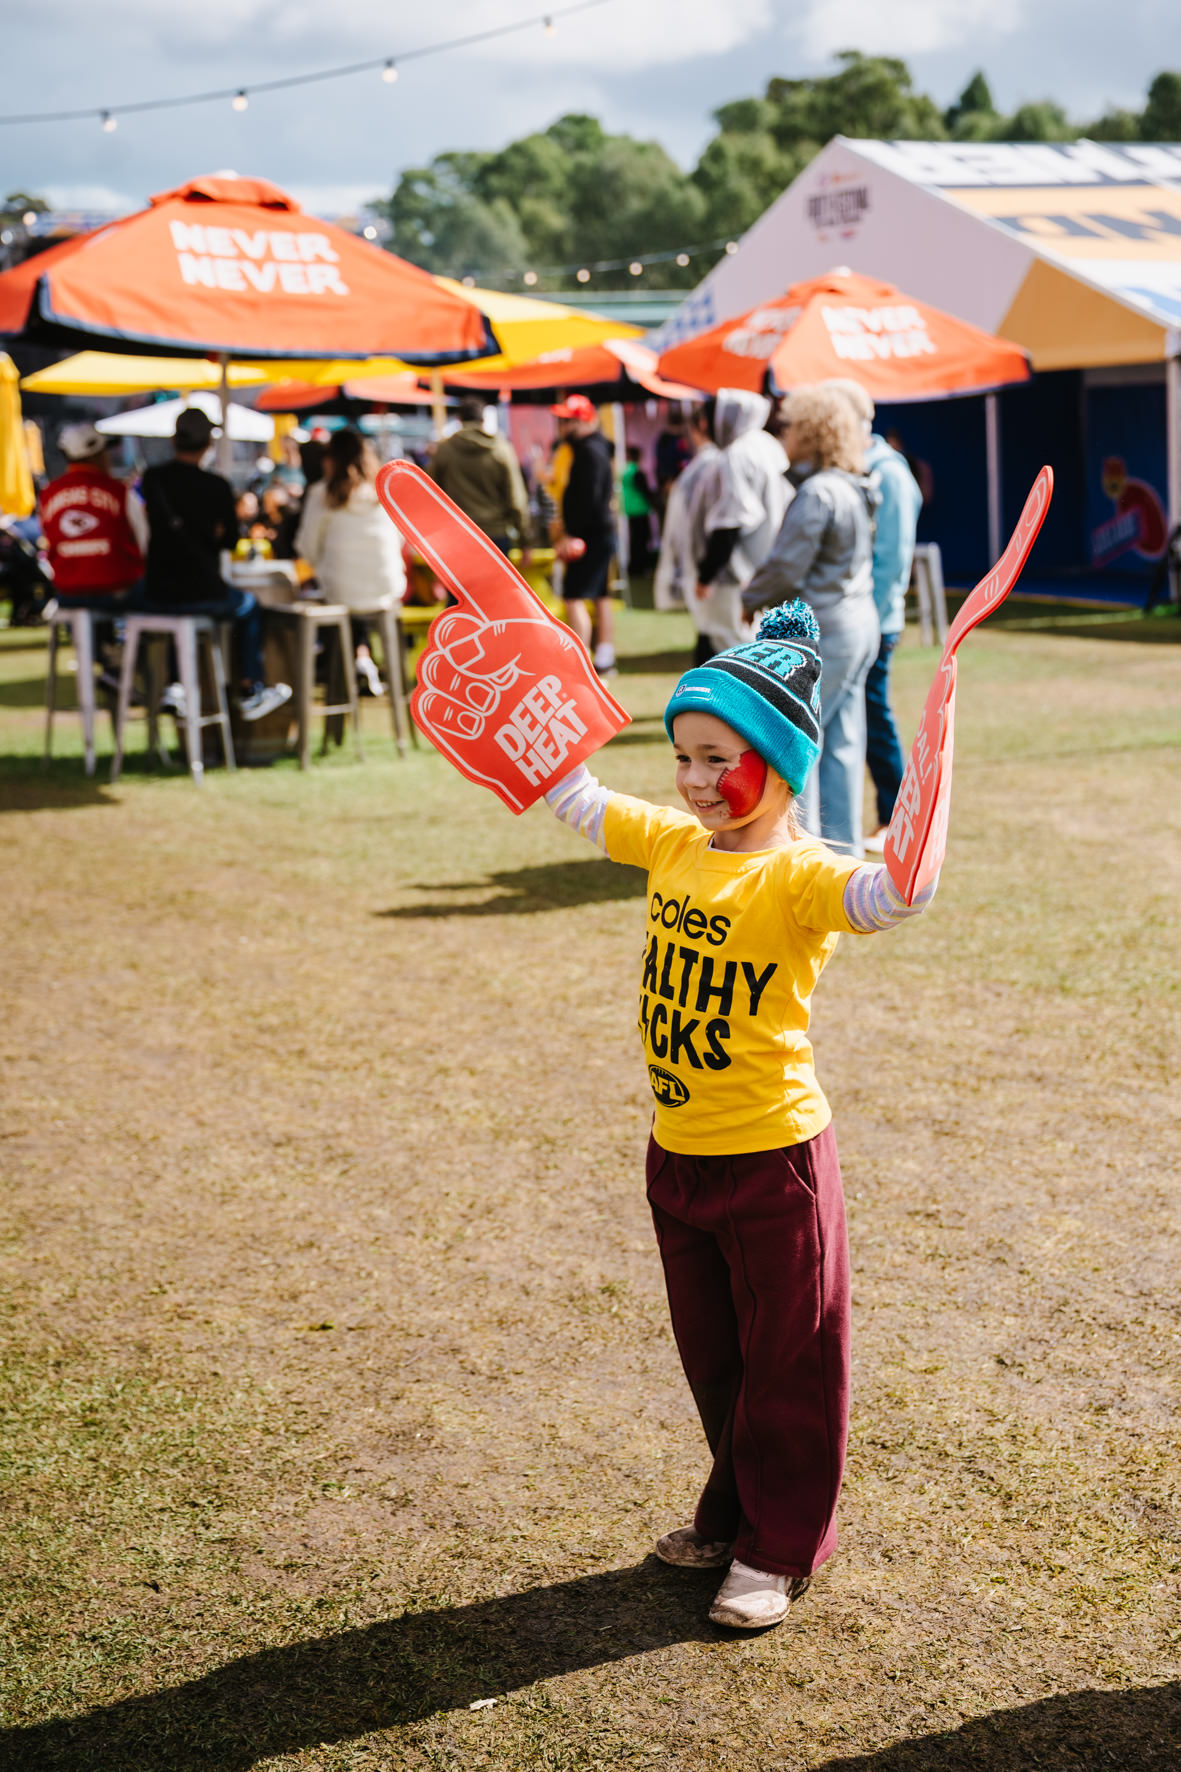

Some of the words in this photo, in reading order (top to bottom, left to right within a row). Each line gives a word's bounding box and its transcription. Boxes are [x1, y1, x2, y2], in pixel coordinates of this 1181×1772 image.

[169, 220, 340, 262] NEVER
[177, 252, 350, 296] NEVER
[821, 305, 926, 333] NEVER
[829, 330, 937, 360] NEVER
[493, 674, 563, 762] DEEP
[514, 698, 589, 788] HEAT
[650, 891, 731, 946] coles
[642, 930, 778, 1017] ALTHY
[638, 994, 732, 1071] ICKS
[650, 1070, 686, 1102] AFL
